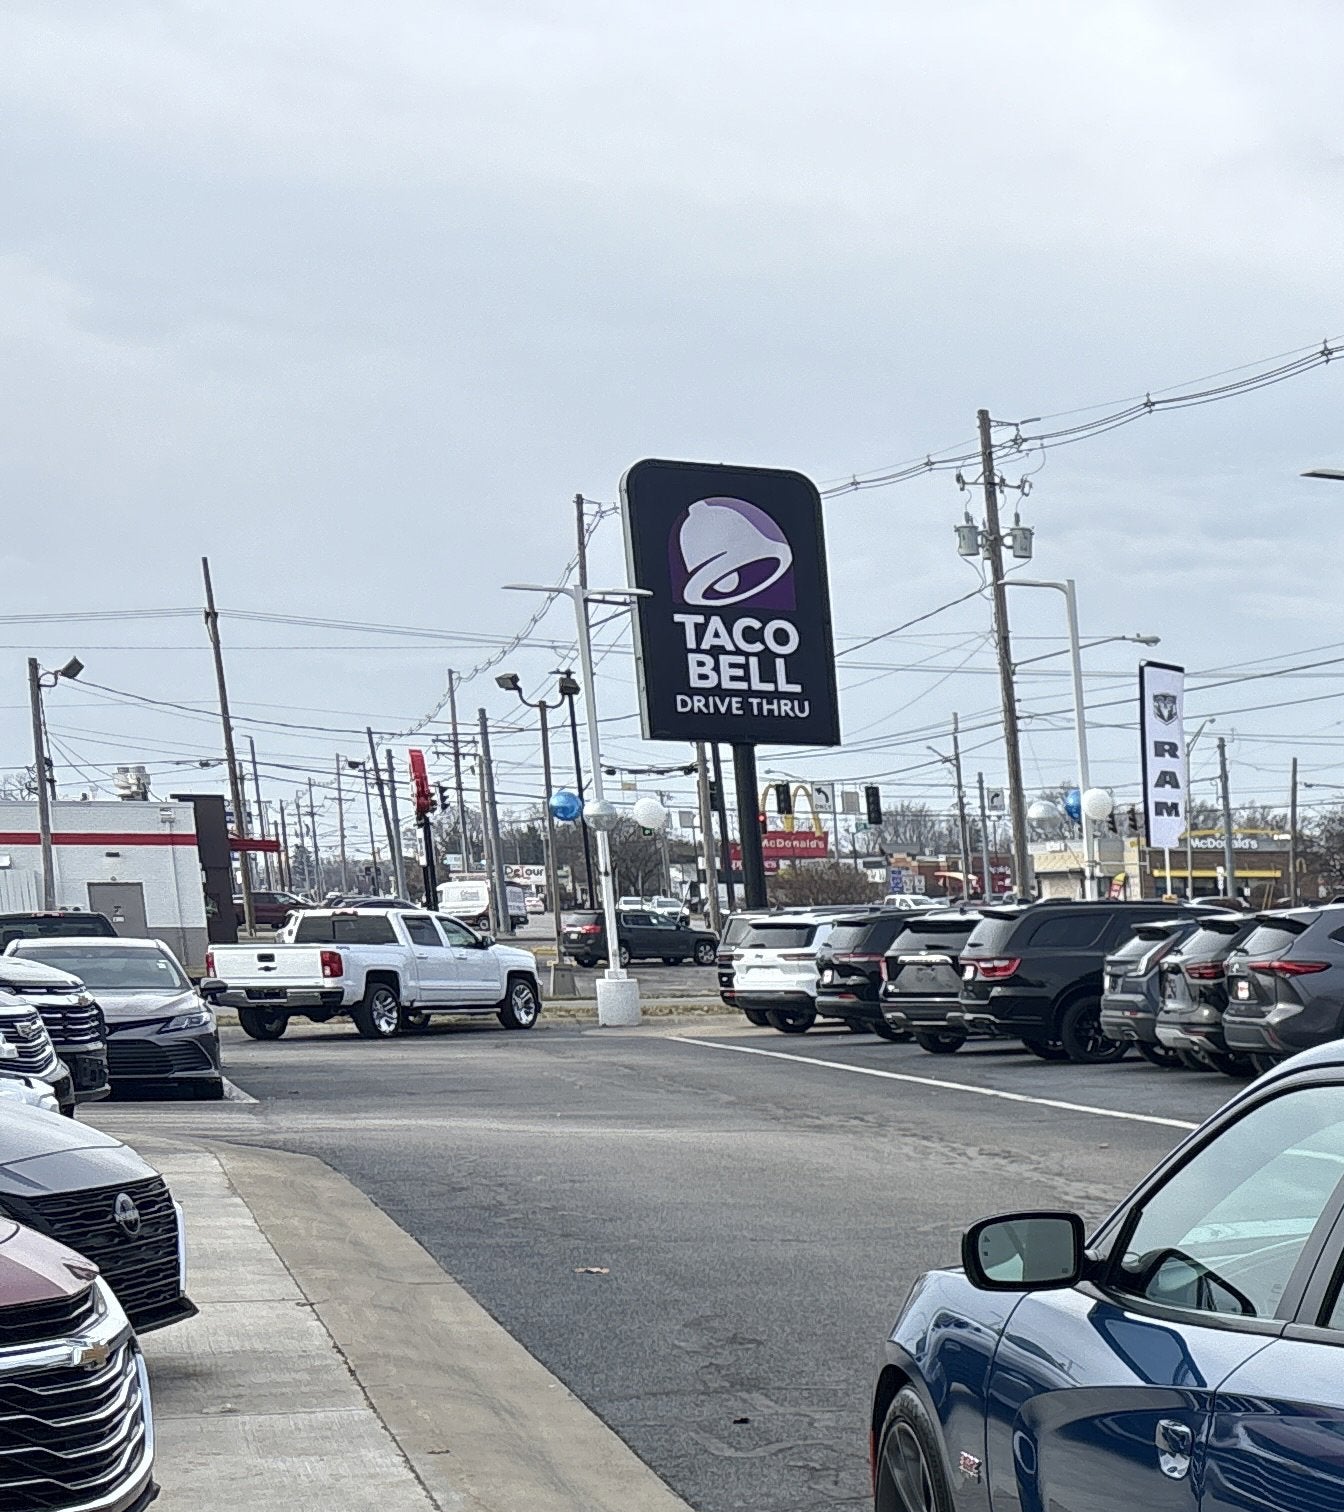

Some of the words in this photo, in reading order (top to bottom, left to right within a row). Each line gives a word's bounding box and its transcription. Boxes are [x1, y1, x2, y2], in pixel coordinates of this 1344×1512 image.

[673, 613, 800, 655] TACO
[687, 652, 803, 693] BELL
[675, 694, 744, 715] DRIVE
[748, 697, 810, 718] THRU
[1153, 740, 1181, 818] RAM
